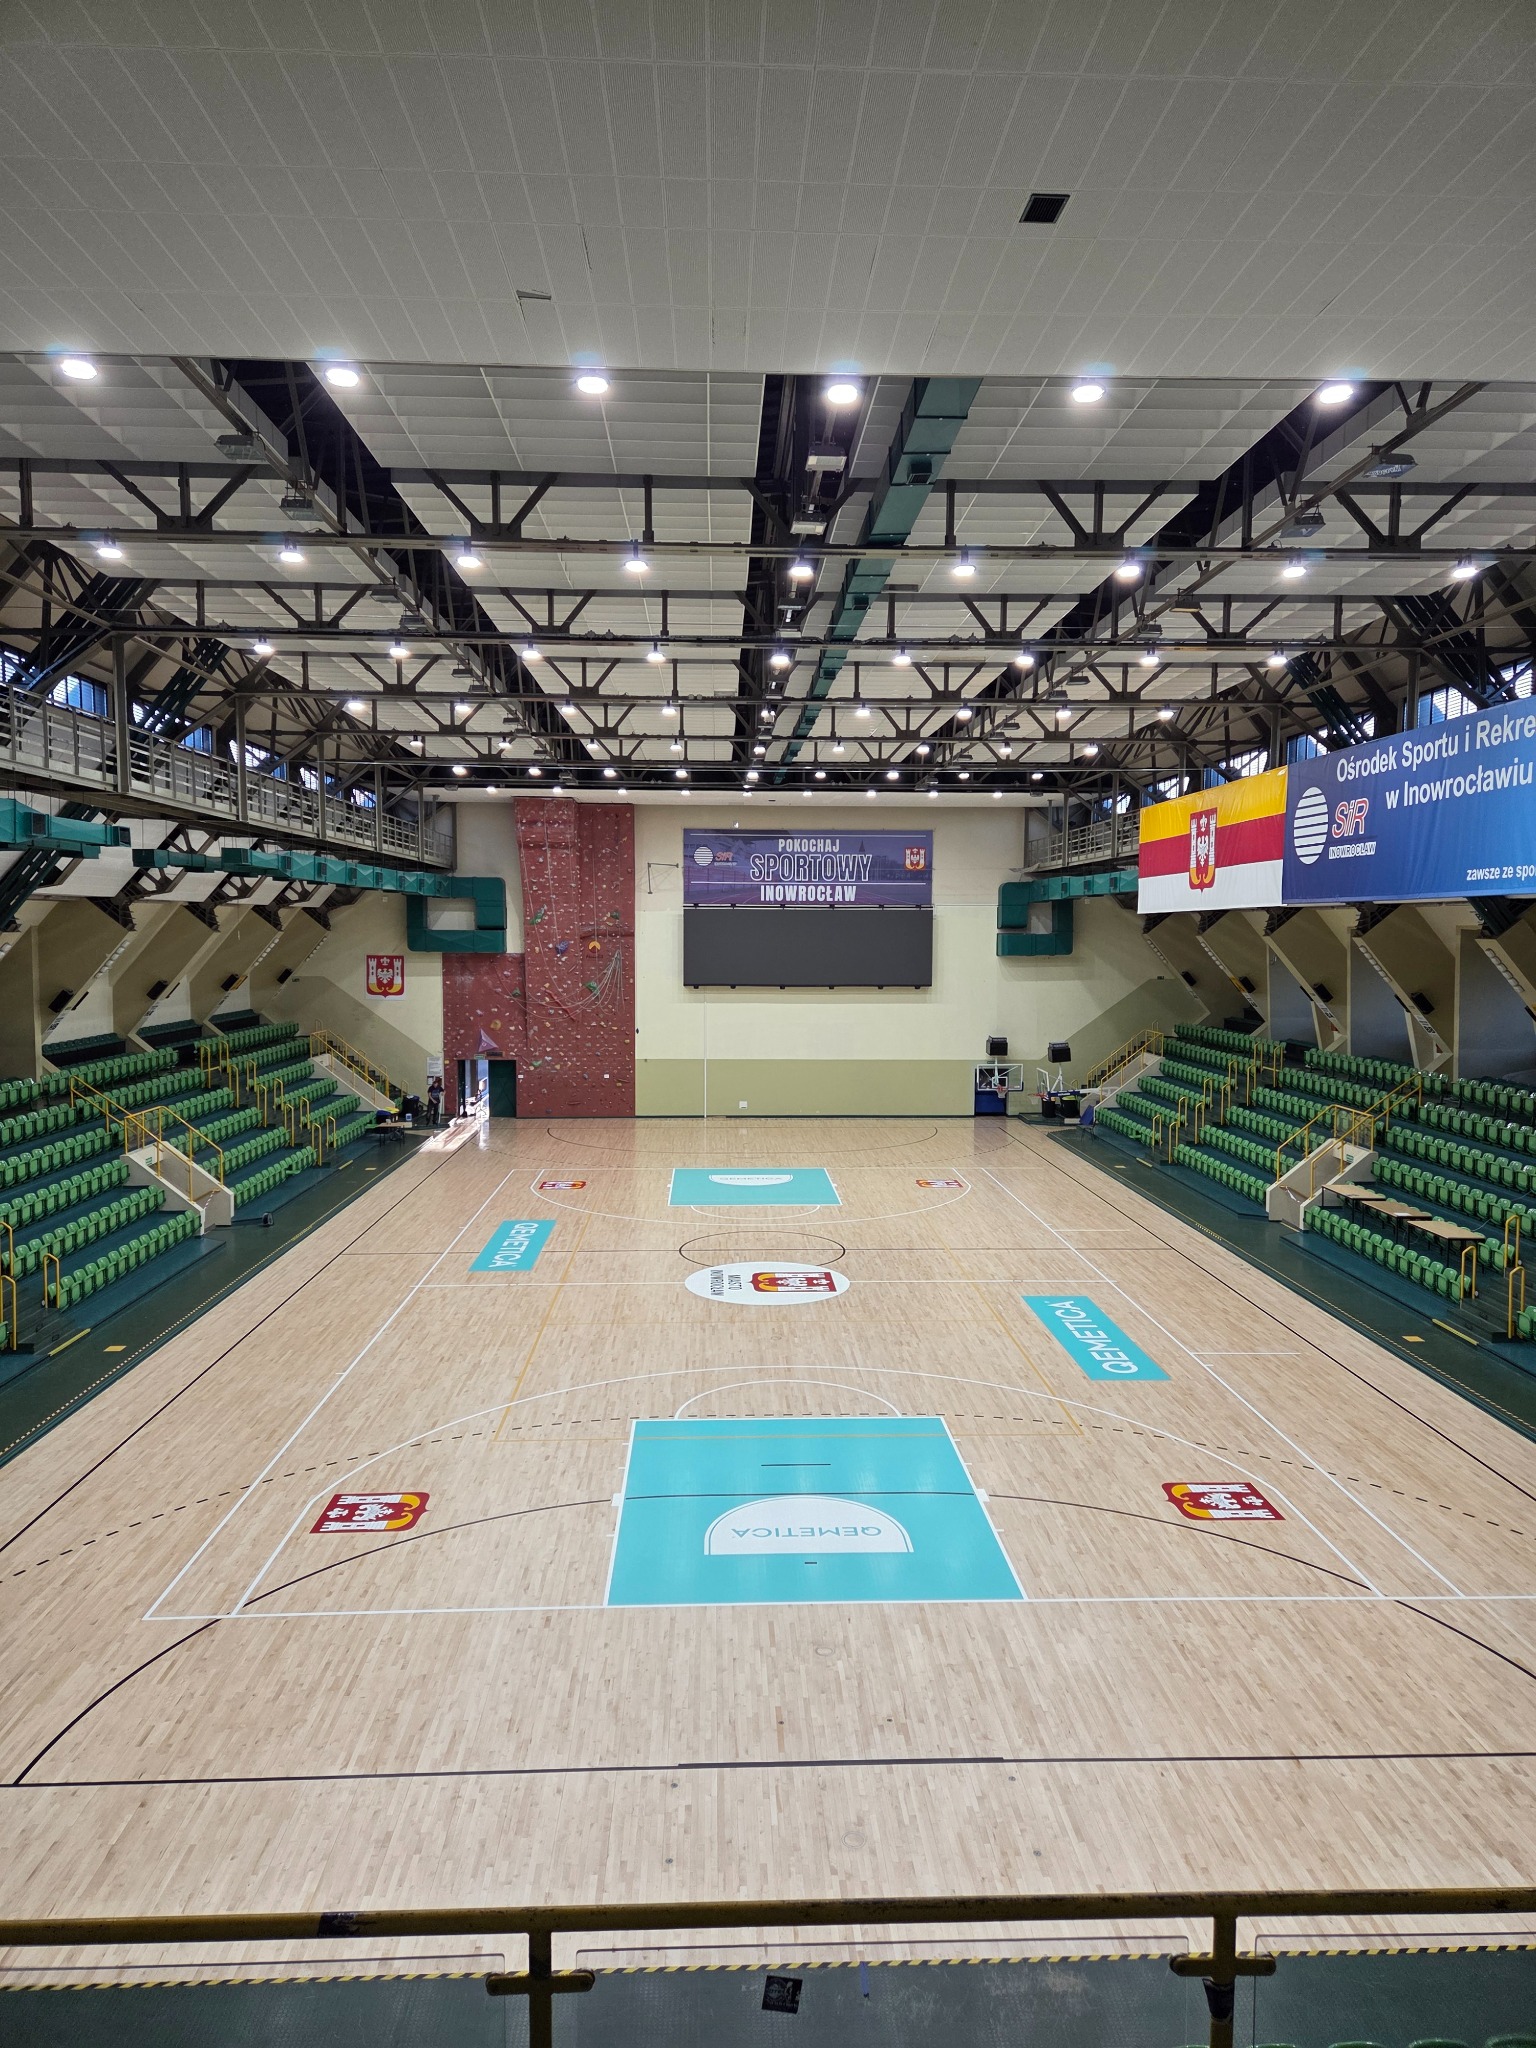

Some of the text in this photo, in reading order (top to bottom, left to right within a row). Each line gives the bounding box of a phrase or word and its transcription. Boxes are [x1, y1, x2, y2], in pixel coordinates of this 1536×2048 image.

[1337, 714, 1536, 782] Ośrodek Sportu i Rekre
[1385, 757, 1533, 809] w Inowrocławiu
[1332, 798, 1369, 838] SiR
[778, 838, 840, 853] POKOCHAJ
[749, 853, 873, 881] SPORTOWY
[1466, 864, 1536, 881] zawsze ze spo
[760, 885, 857, 902] INOWROCŁAW
[488, 1222, 539, 1268] QEMETICA
[1047, 1300, 1139, 1374] QEMETICA
[731, 1526, 882, 1538] QEMETICA
